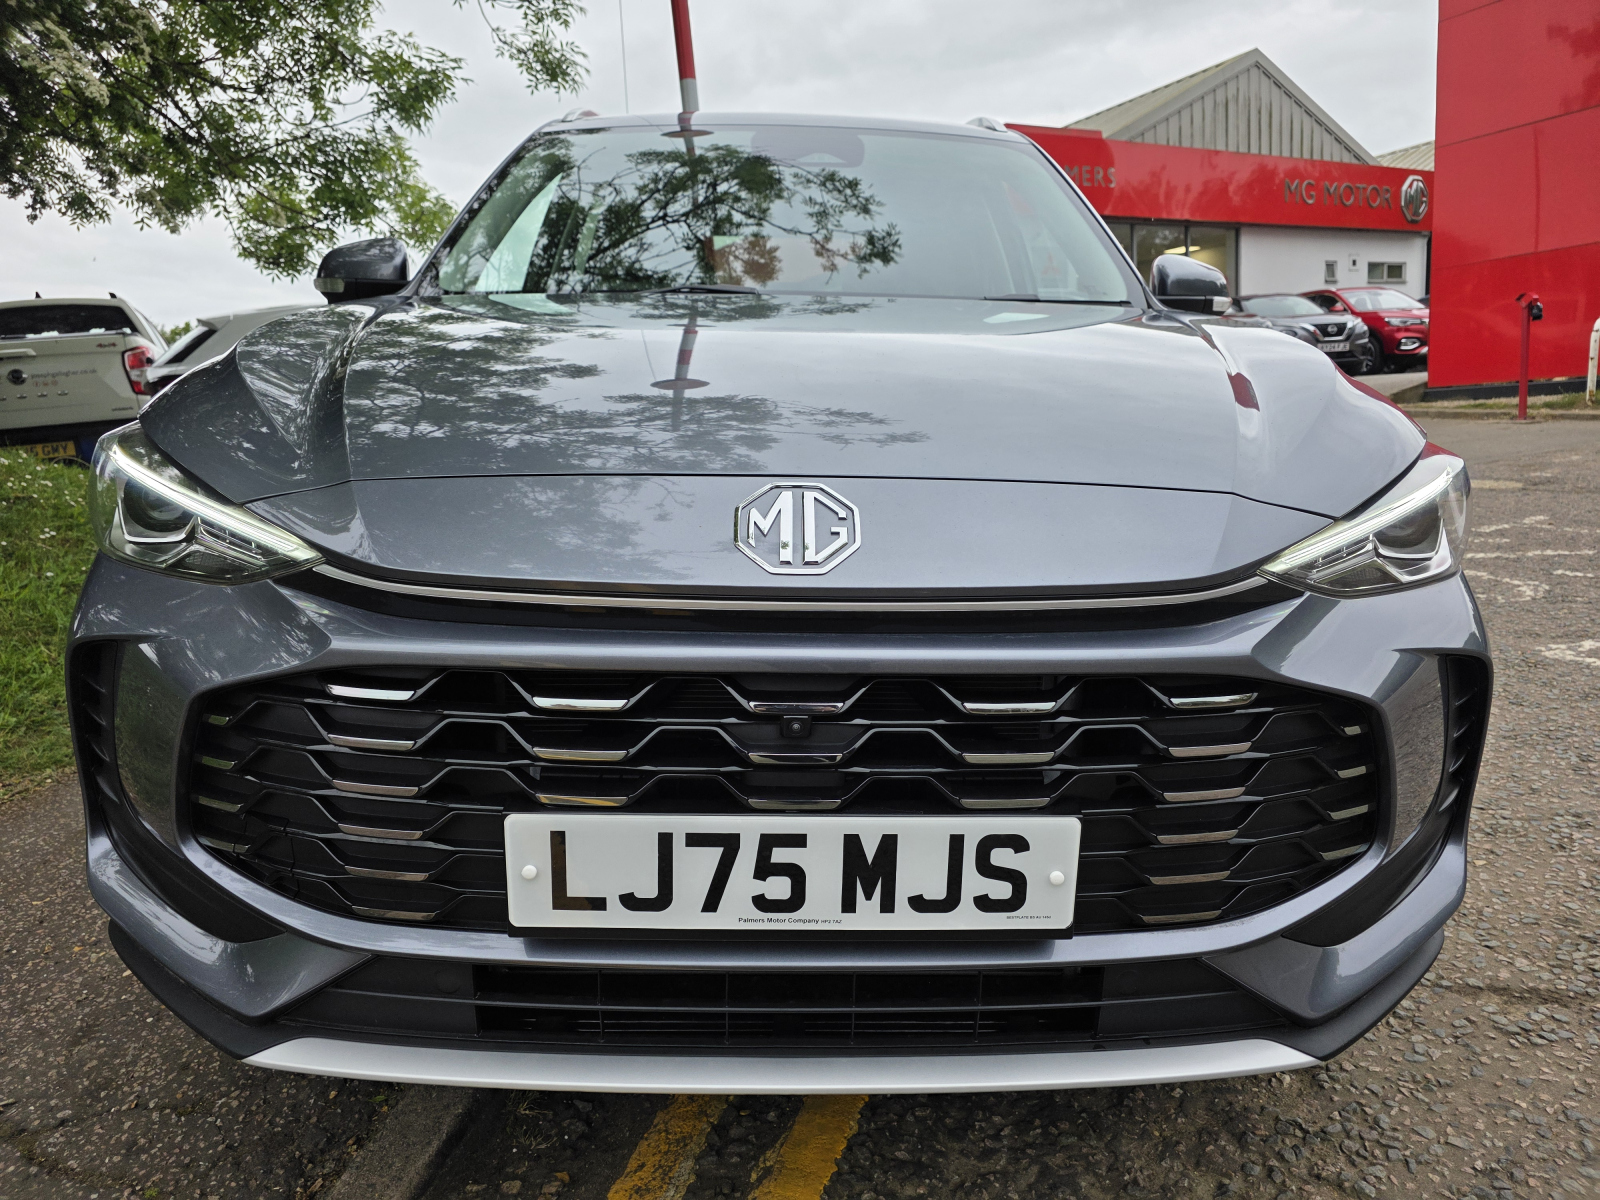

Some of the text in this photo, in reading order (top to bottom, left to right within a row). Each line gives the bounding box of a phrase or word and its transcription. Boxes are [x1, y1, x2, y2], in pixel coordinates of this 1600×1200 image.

[1284, 178, 1392, 210] MG MOTOR
[1404, 179, 1429, 218] MG
[747, 490, 848, 565] MG
[549, 830, 1031, 914] LJ75 MJS
[787, 917, 820, 925] Company
